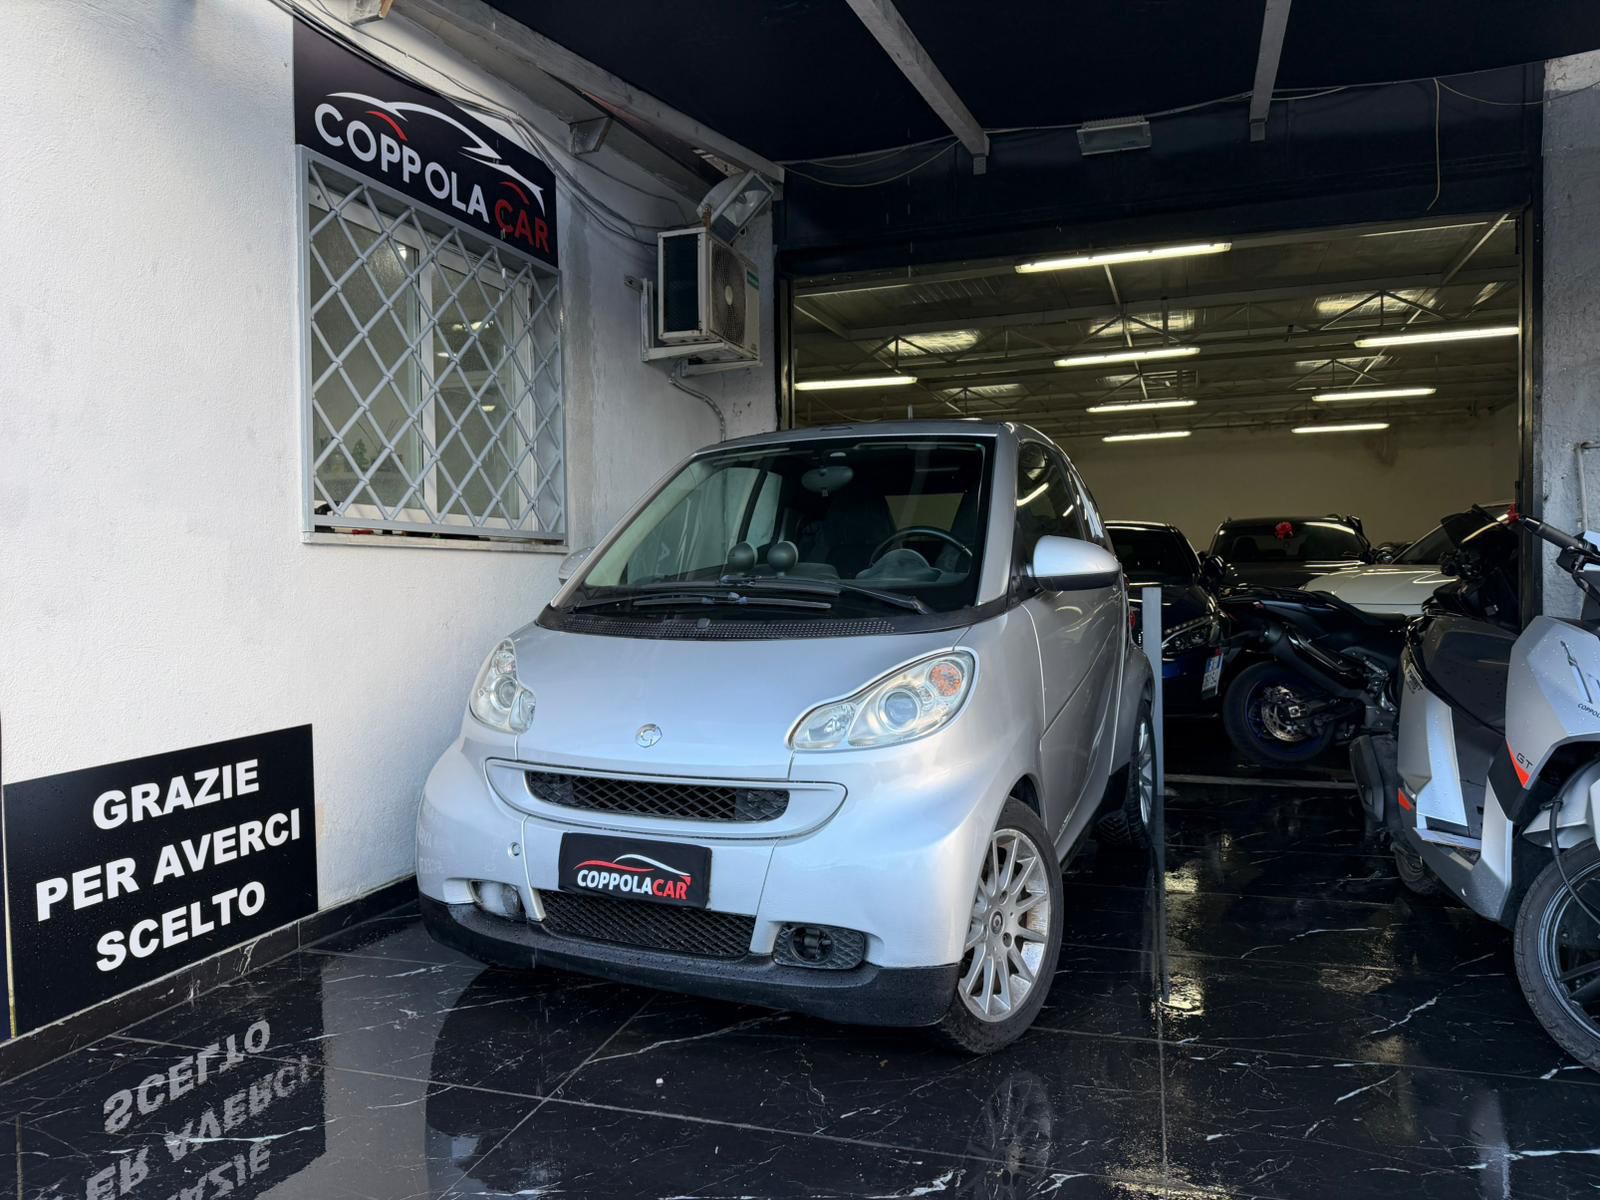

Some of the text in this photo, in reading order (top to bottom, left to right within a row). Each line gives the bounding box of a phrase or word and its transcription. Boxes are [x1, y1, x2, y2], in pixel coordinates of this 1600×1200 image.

[314, 103, 550, 253] COPPOLA CAR
[92, 758, 260, 830] GRAZIE
[1516, 752, 1533, 769] GT
[36, 807, 300, 922] PER AVERCI
[577, 868, 688, 900] COPPOLACAR
[96, 881, 265, 972] SCELTO
